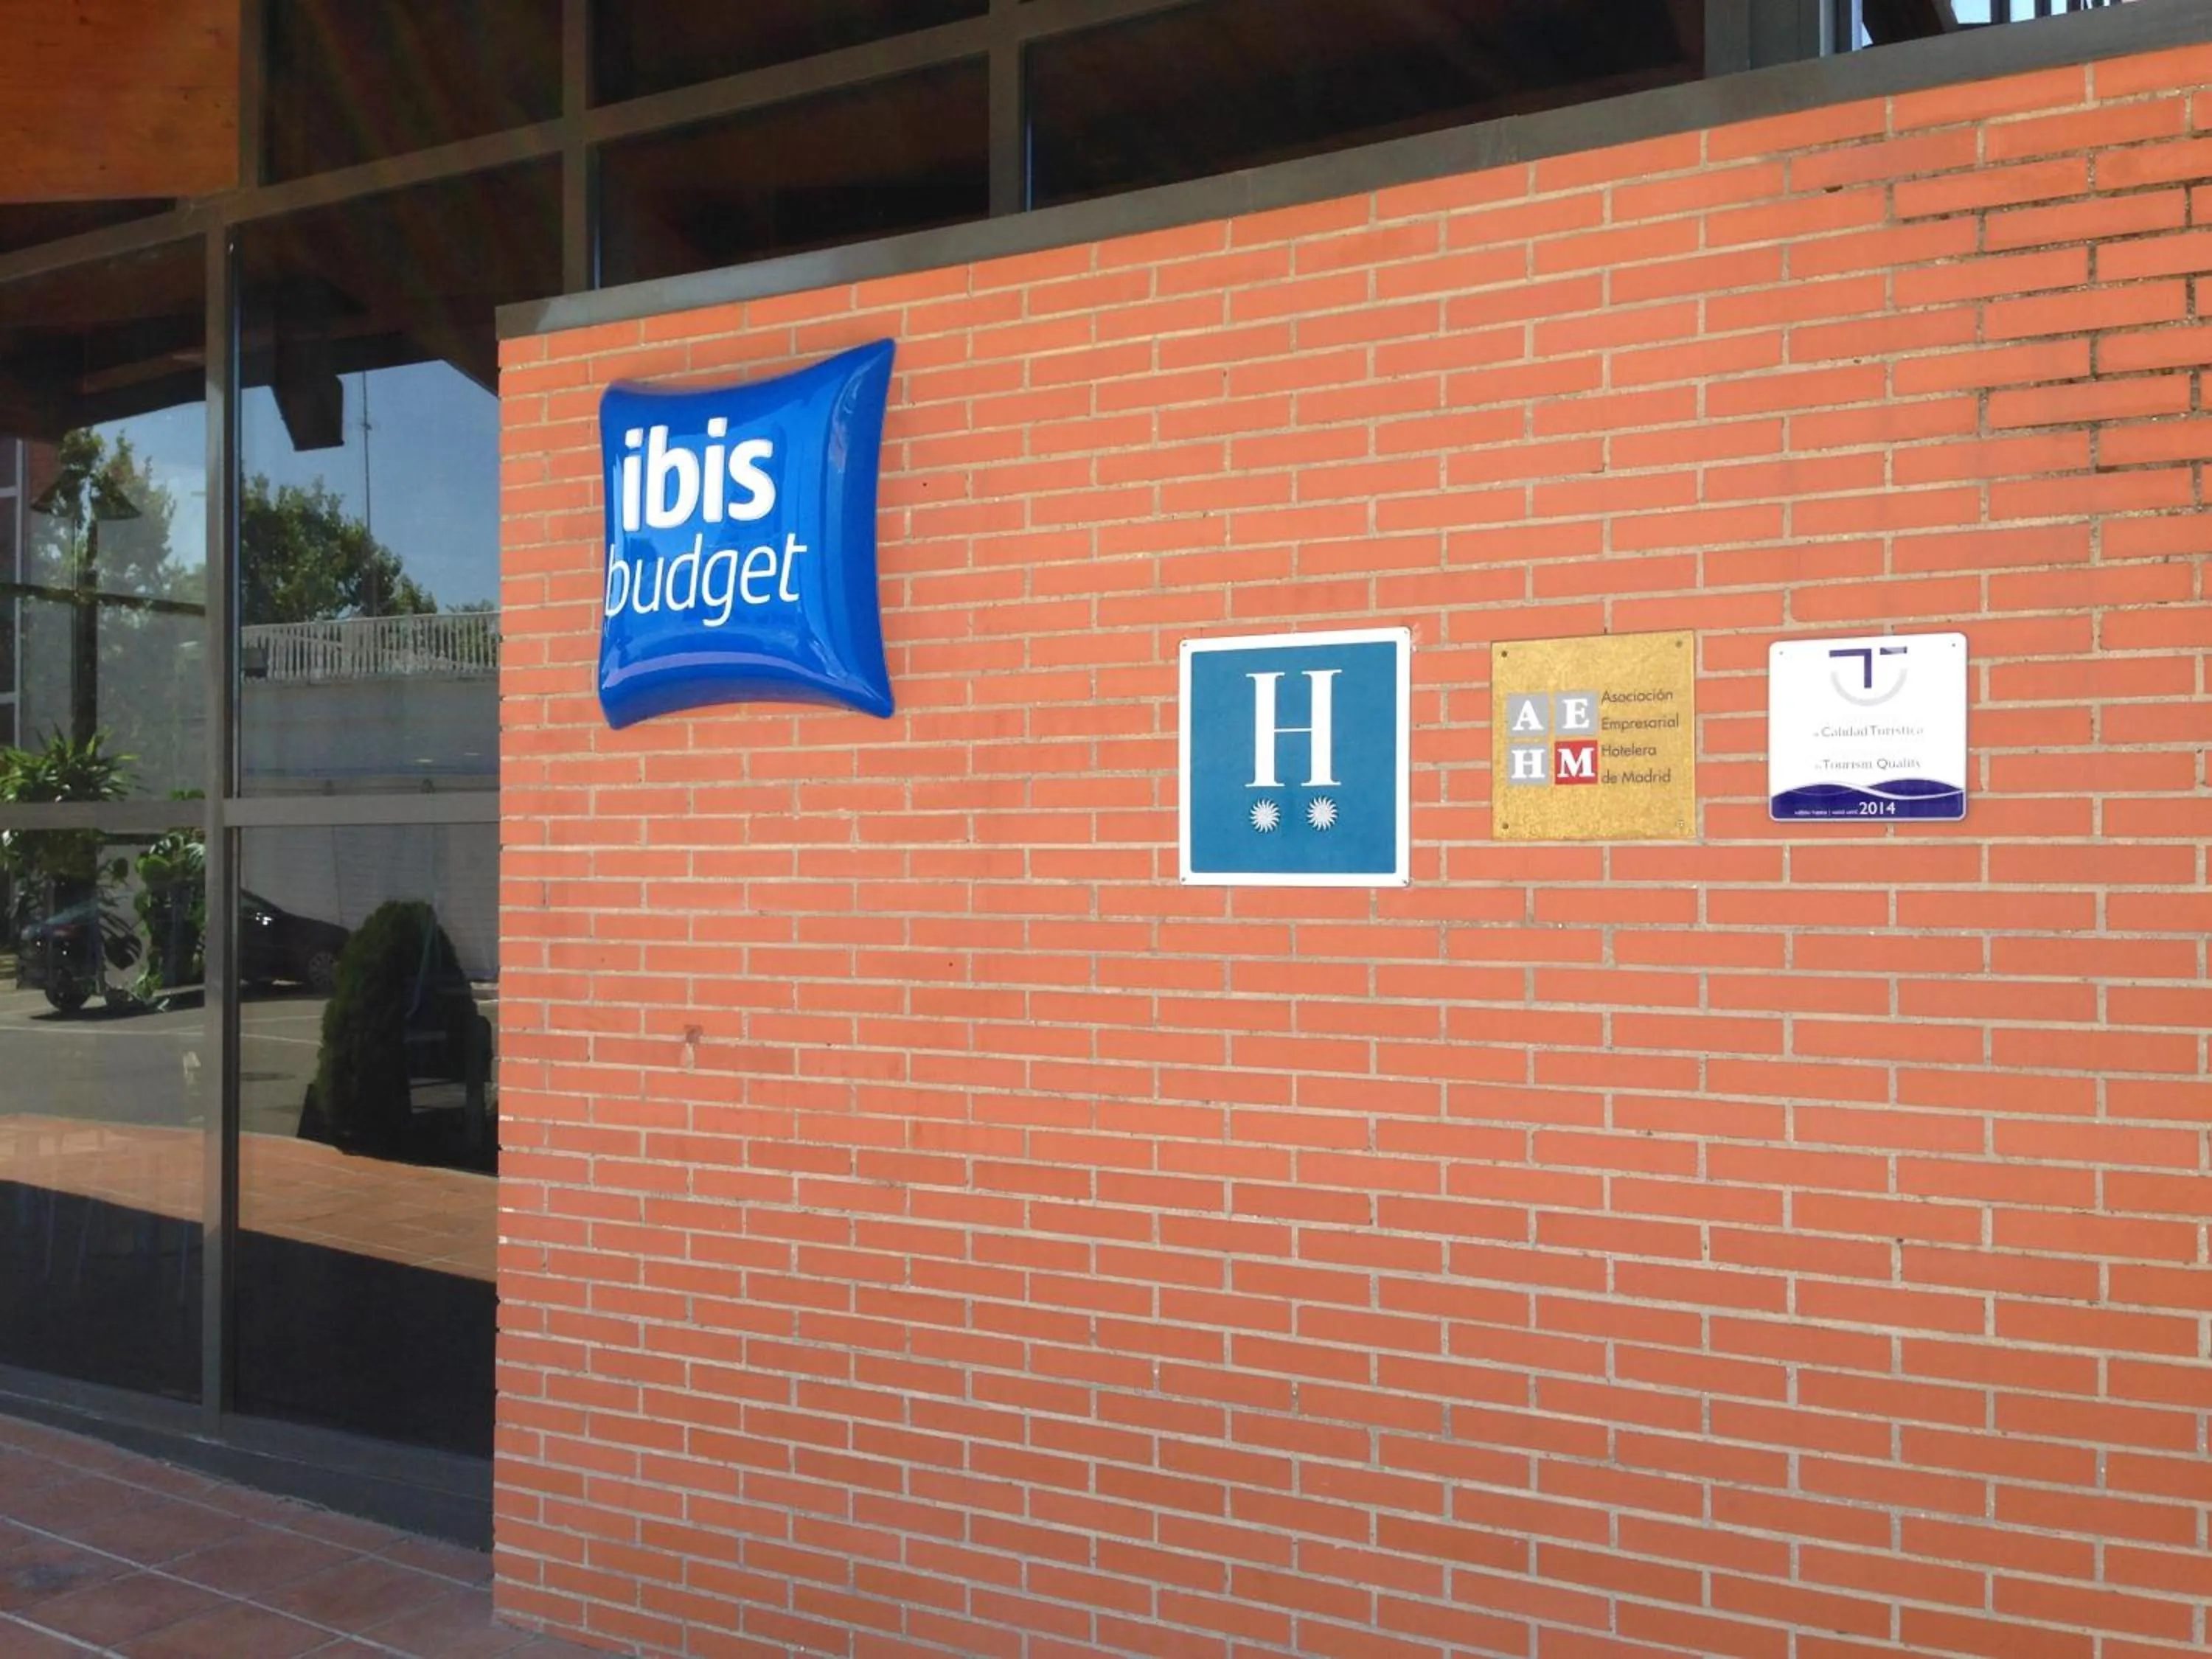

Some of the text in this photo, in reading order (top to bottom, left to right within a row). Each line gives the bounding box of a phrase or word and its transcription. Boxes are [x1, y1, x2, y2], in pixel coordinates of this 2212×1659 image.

[623, 417, 776, 532] ibis
[605, 533, 807, 627] budget
[1601, 689, 1673, 703] Asociación
[1245, 669, 1342, 788] H
[1601, 712, 1680, 733] Empresarial
[1601, 743, 1657, 757] Hotelera
[1823, 759, 1872, 770] Tourism
[1601, 768, 1672, 784] de Madrid
[1859, 801, 1896, 815] 2014
